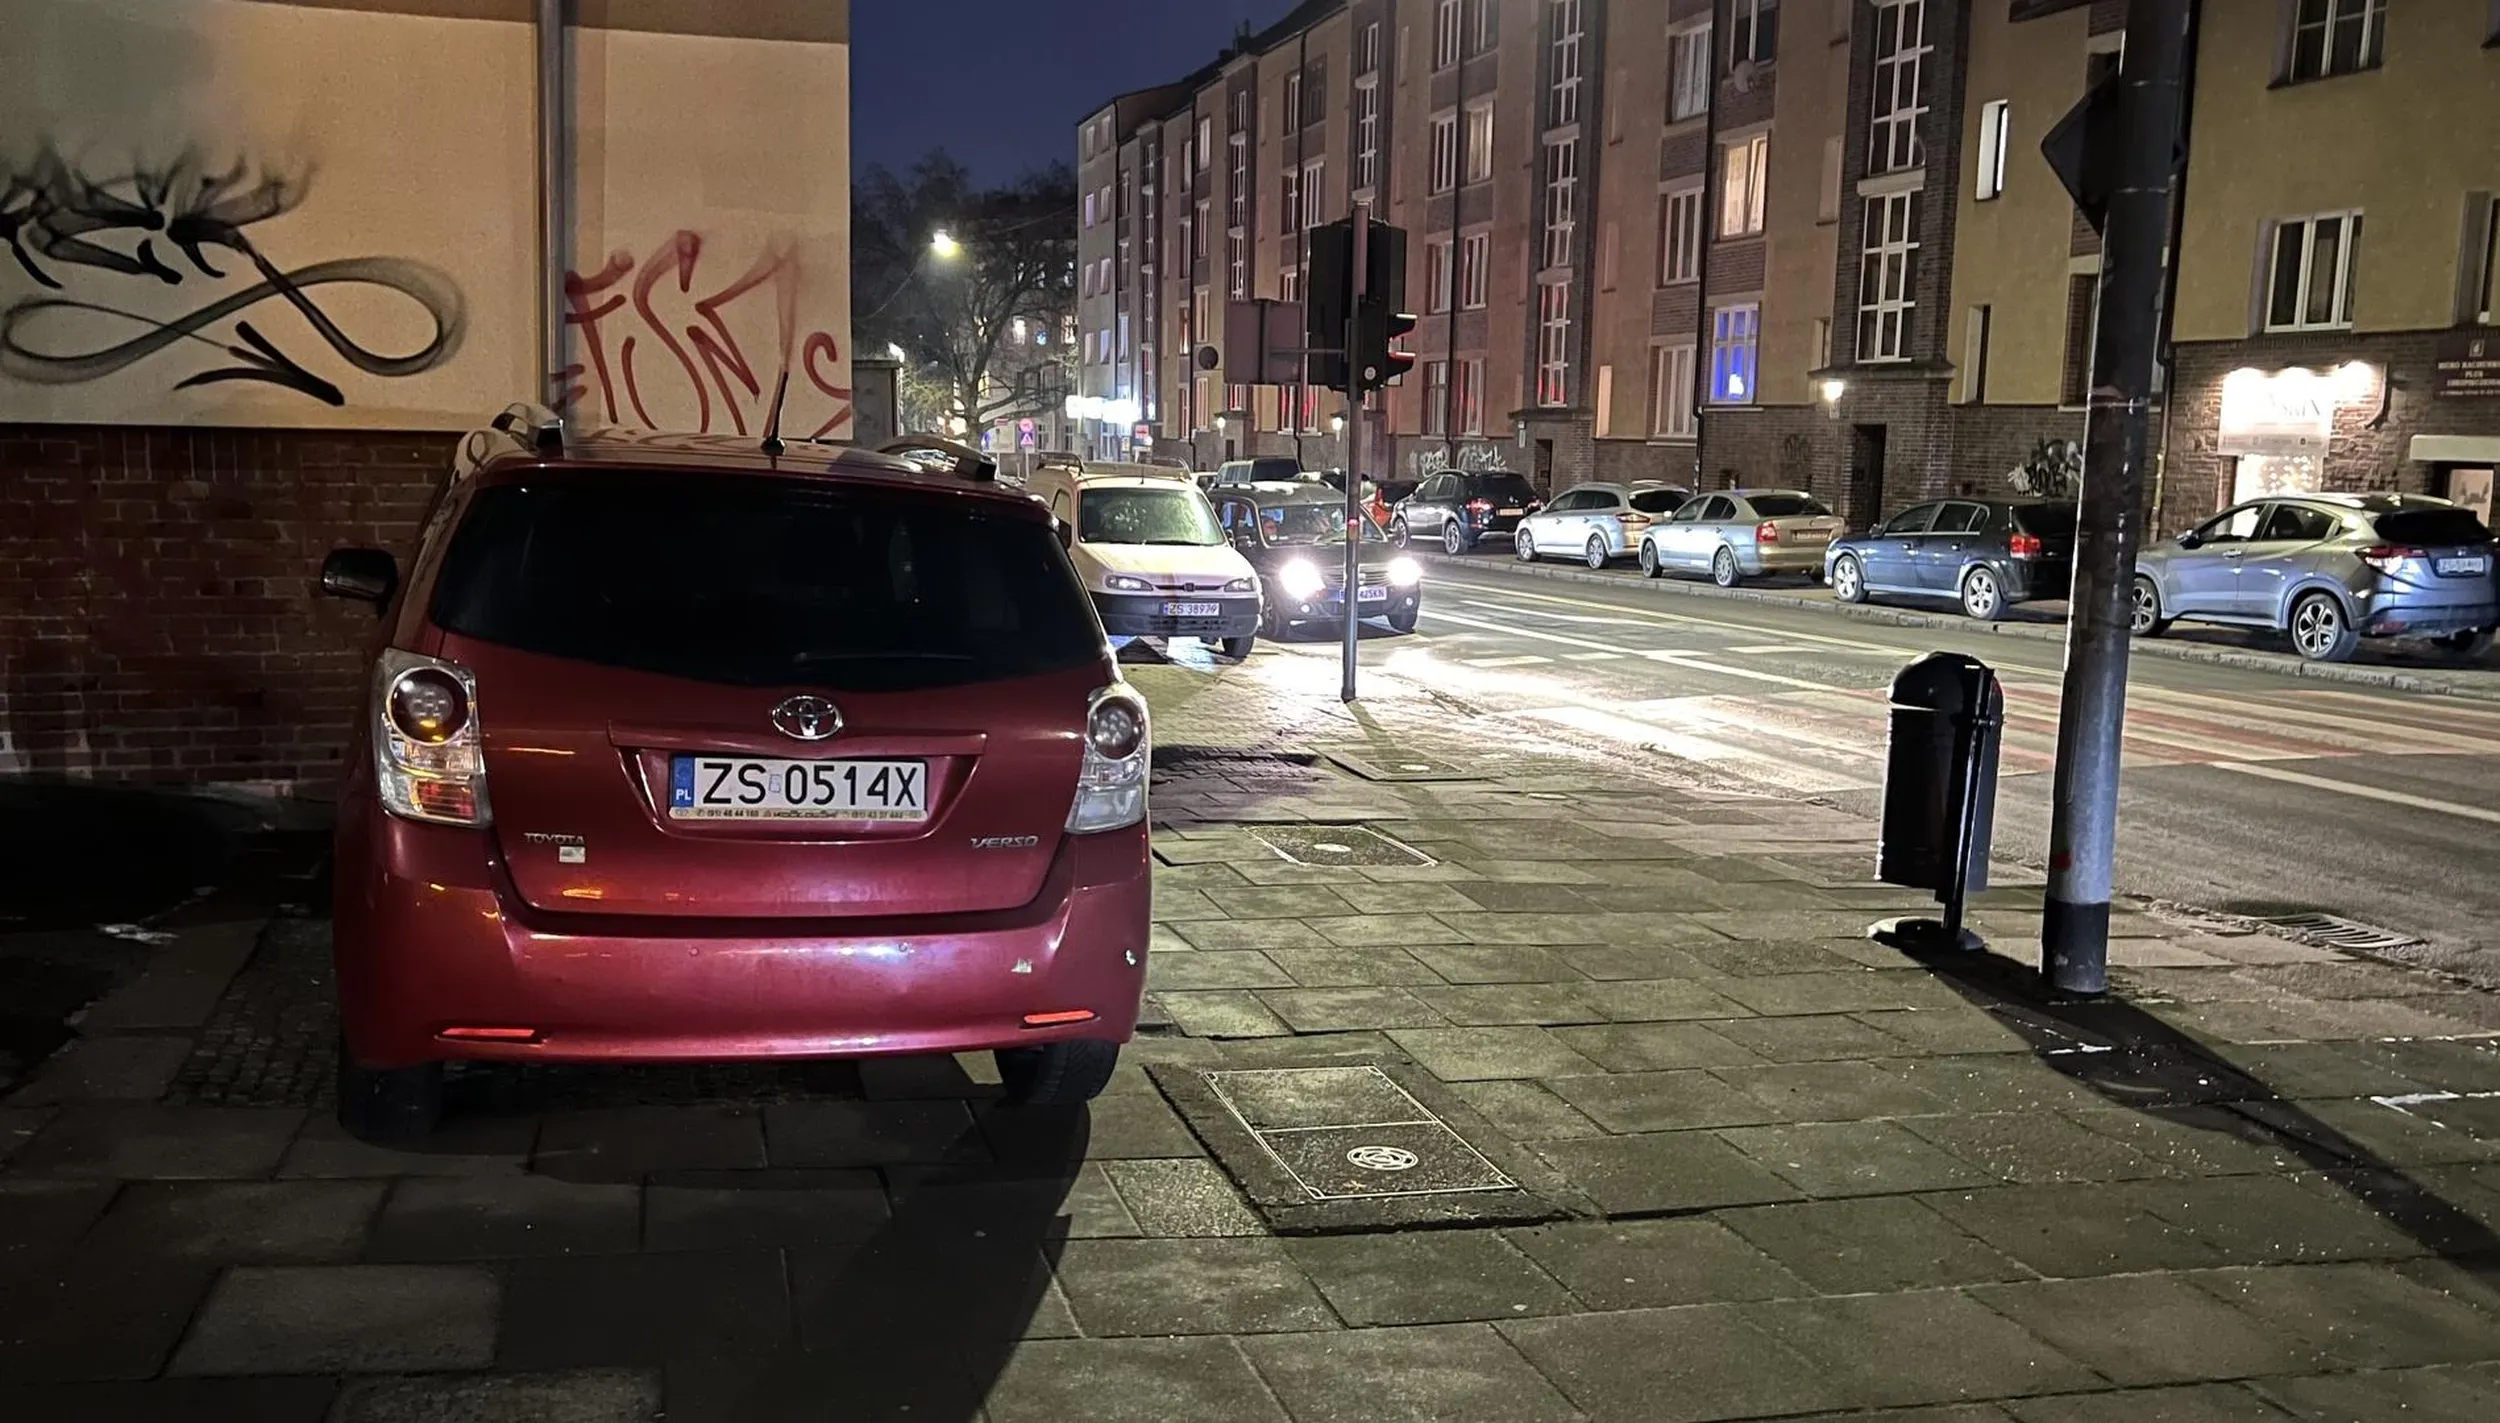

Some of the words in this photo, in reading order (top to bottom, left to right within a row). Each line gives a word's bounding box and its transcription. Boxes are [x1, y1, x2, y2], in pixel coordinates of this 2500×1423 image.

[702, 762, 767, 805] ZS
[784, 763, 918, 807] 0514X
[676, 789, 692, 801] PL
[524, 832, 585, 844] TOYOTA
[970, 835, 1039, 849] VERSO
